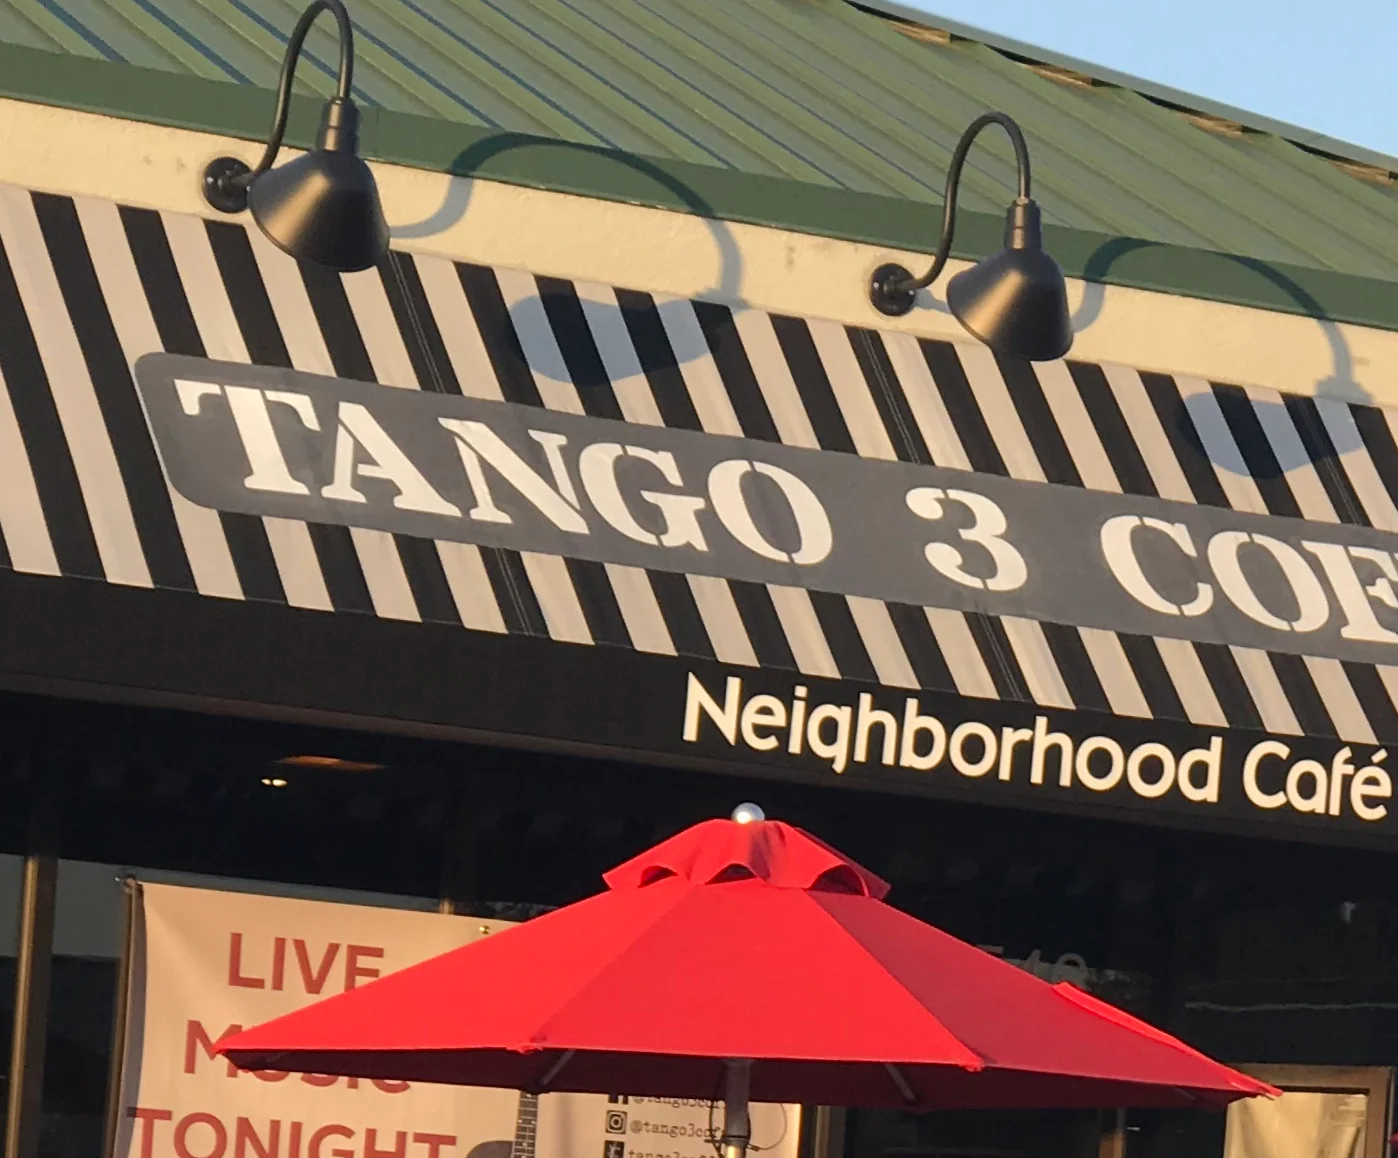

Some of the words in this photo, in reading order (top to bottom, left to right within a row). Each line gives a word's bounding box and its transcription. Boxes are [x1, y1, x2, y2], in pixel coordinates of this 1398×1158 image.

[174, 378, 833, 567] TANGO
[906, 486, 1029, 592] 3
[682, 671, 1224, 803] Neighborhood
[1242, 746, 1393, 822] Café
[227, 932, 385, 995] LIVE
[630, 1119, 725, 1139] @tango3cof
